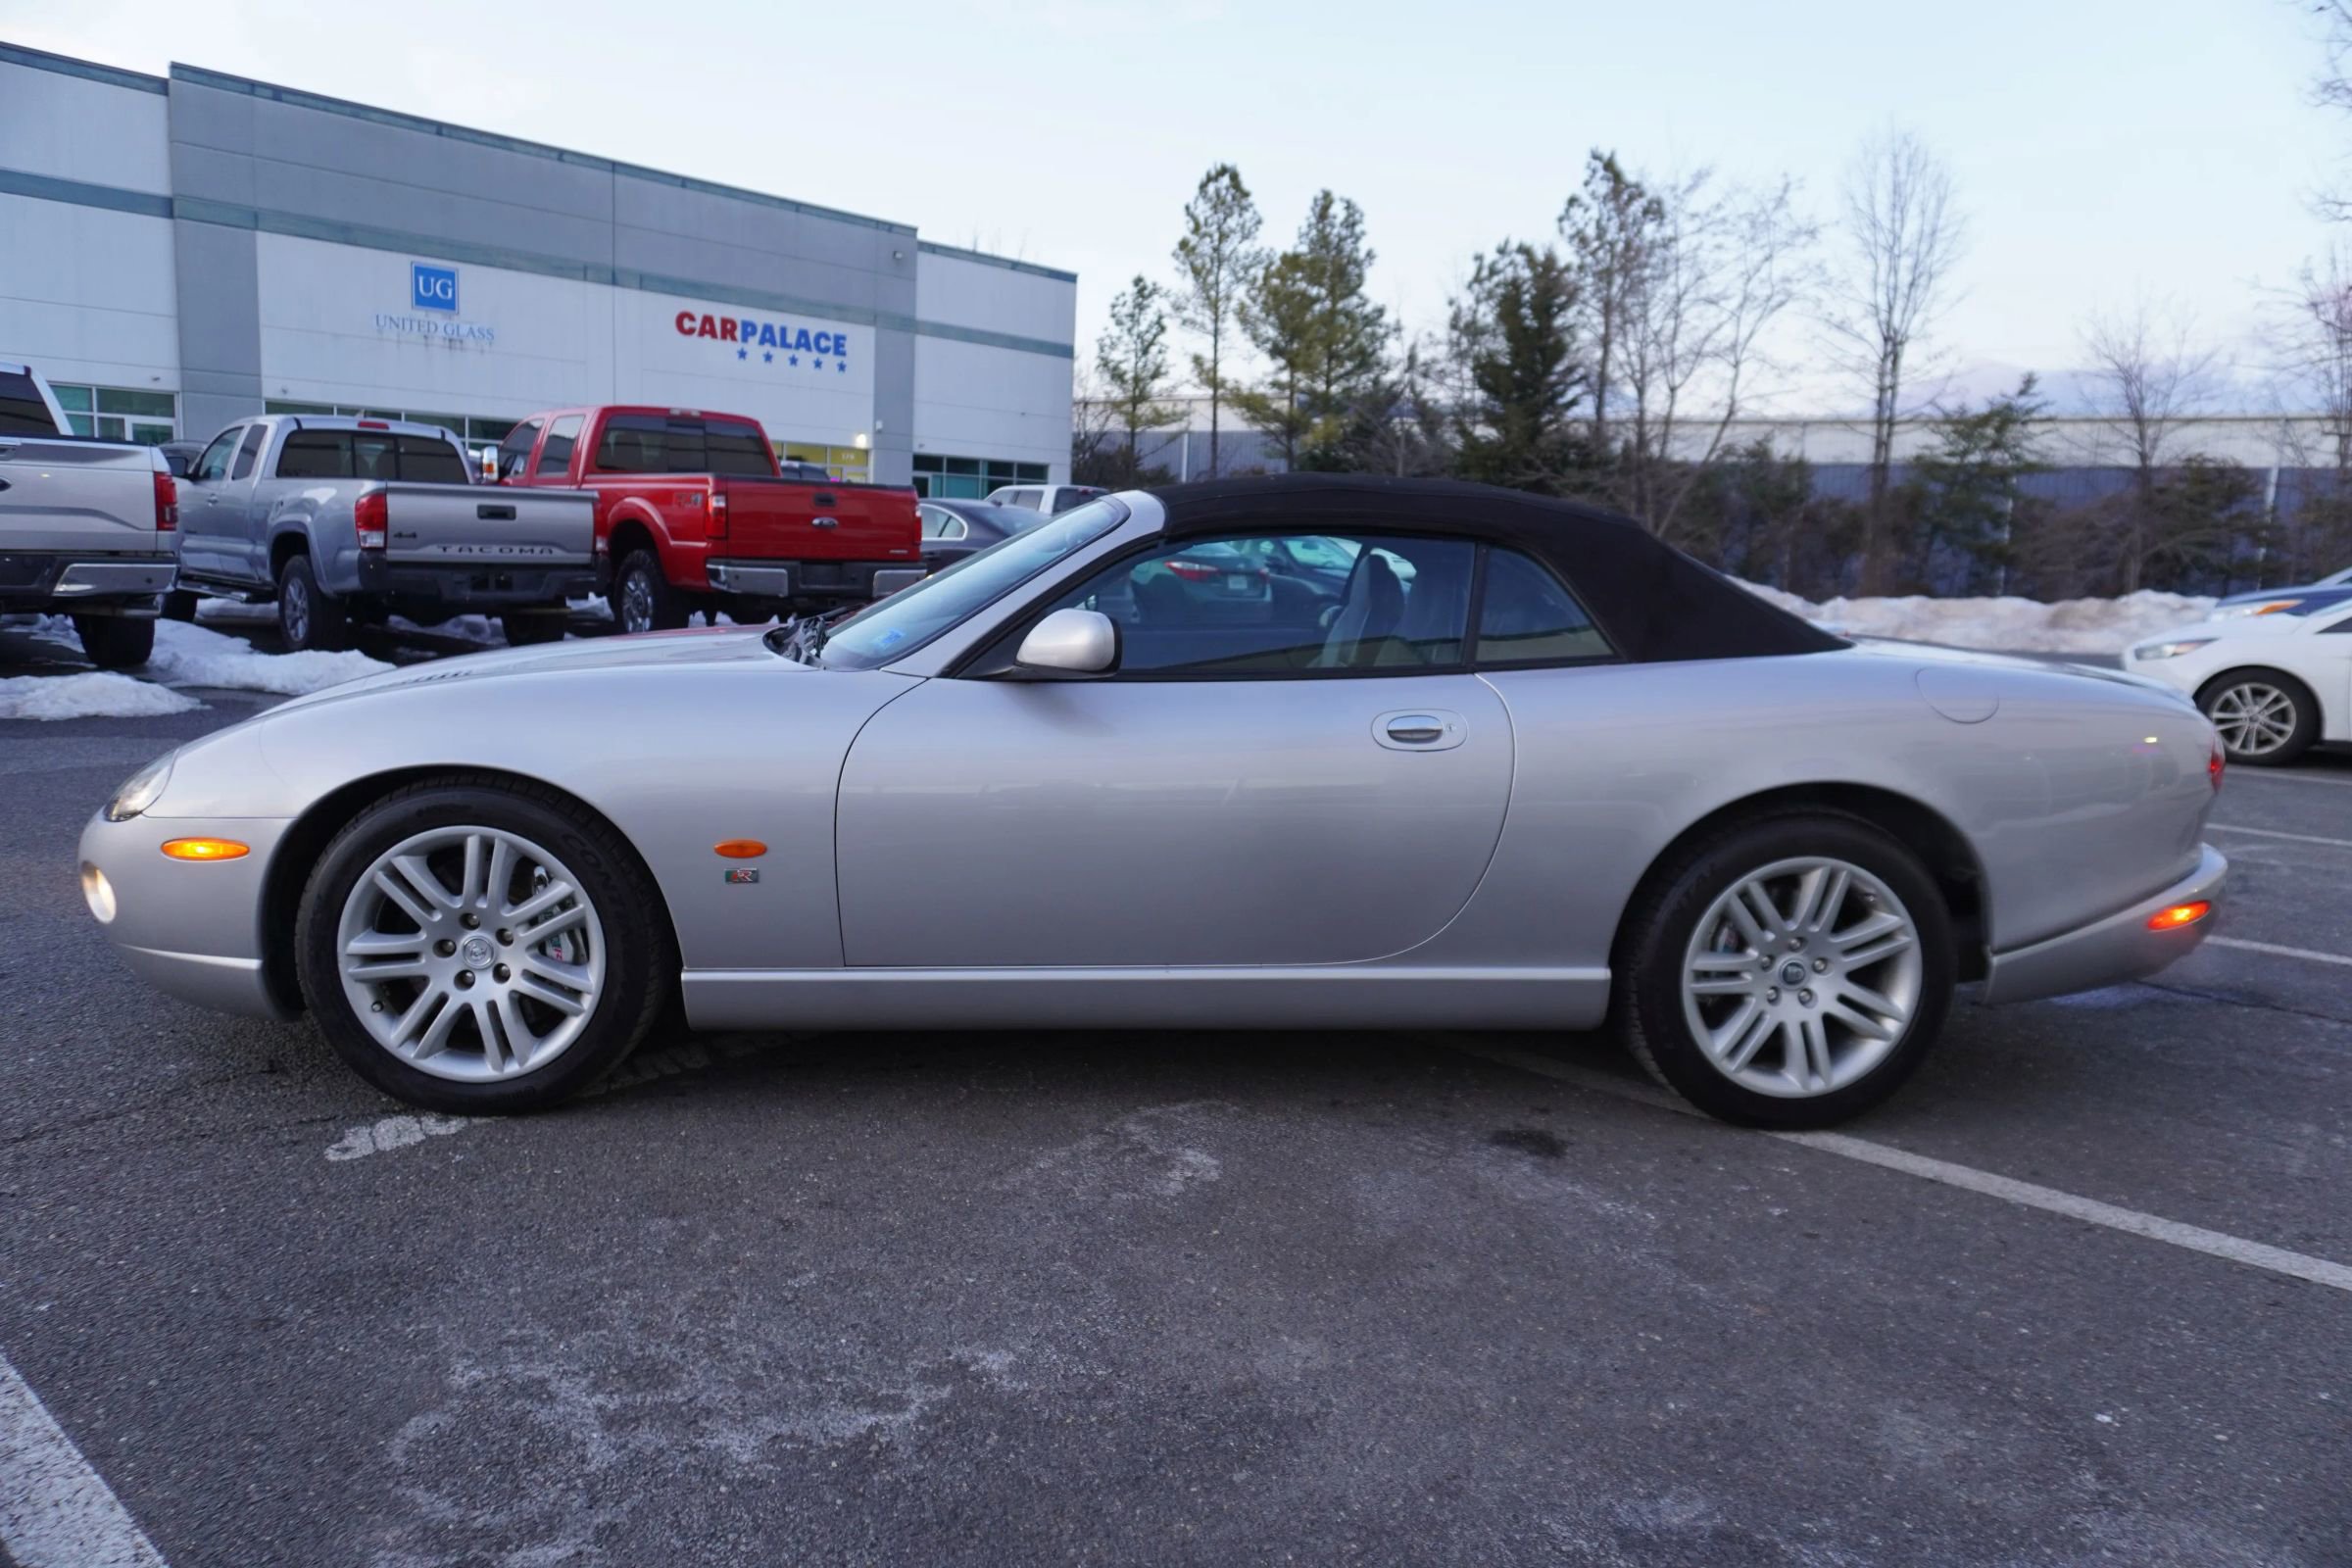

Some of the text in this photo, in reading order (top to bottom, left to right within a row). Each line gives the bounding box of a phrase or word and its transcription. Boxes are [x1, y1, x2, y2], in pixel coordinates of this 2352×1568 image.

[418, 275, 453, 300] UG
[375, 314, 494, 341] UNITED GLASS
[438, 545, 553, 555] TACOMA
